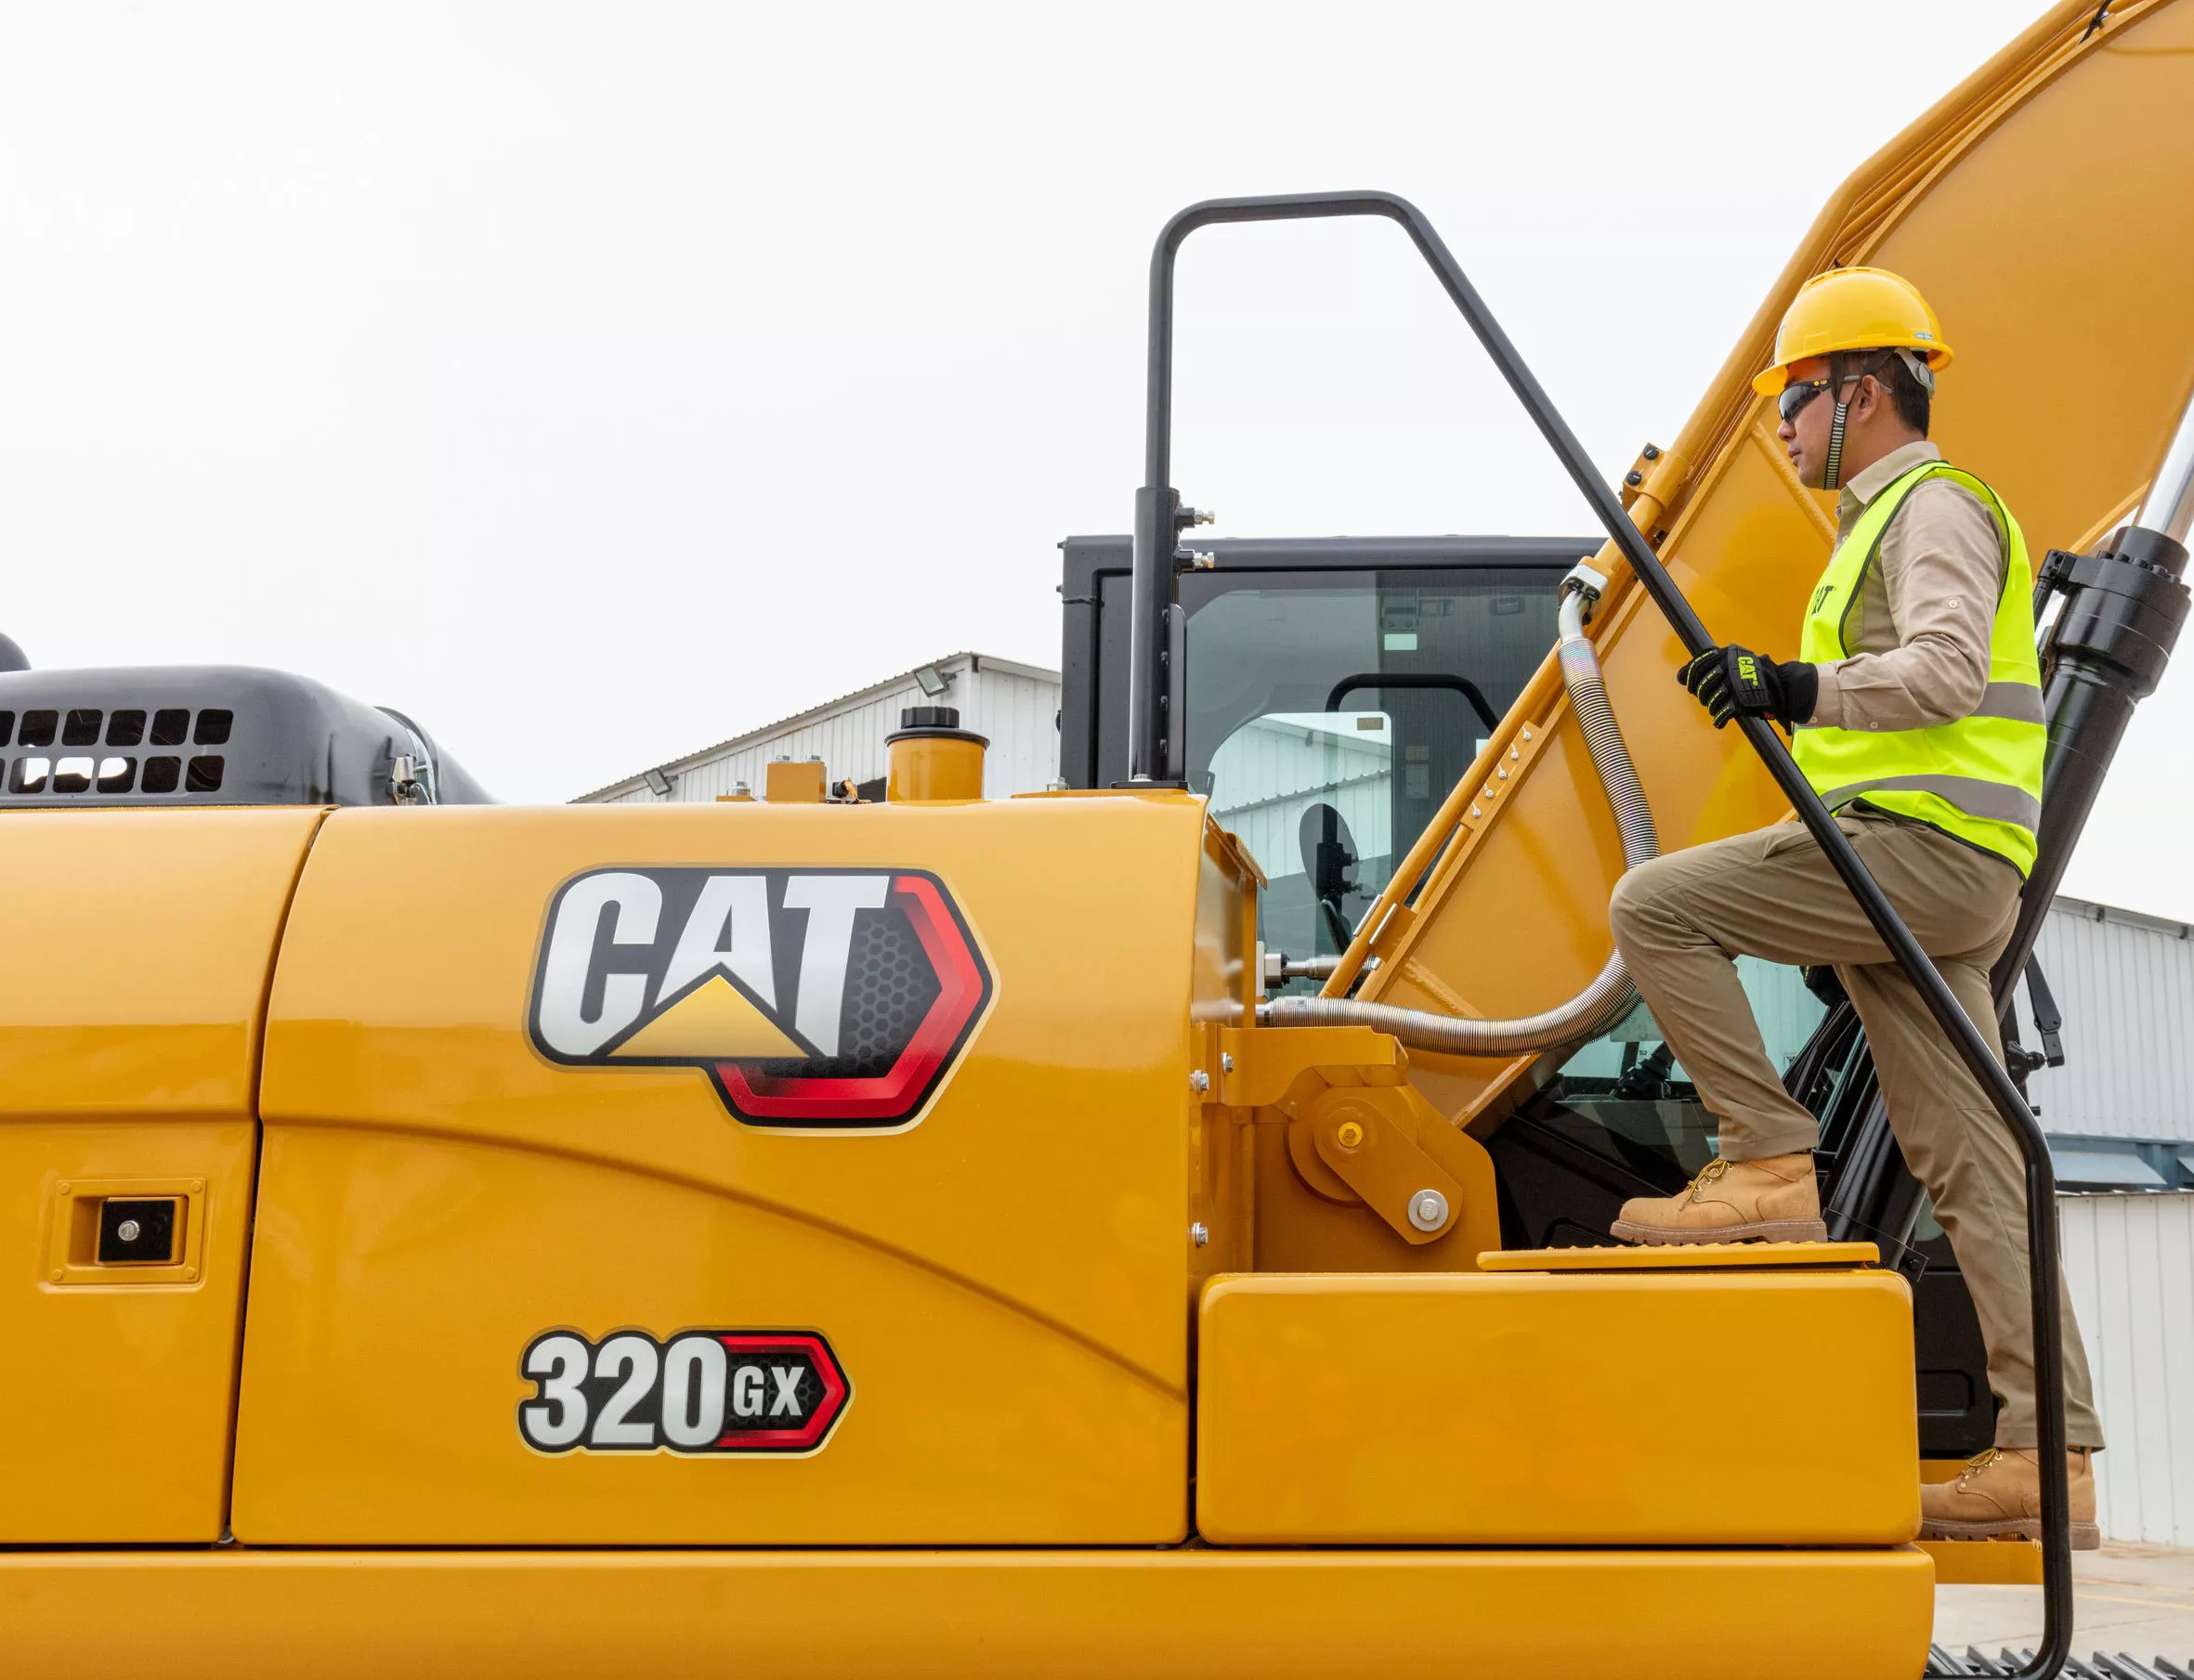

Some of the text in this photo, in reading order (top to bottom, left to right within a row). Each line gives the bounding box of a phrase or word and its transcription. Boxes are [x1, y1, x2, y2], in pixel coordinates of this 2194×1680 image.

[1738, 656, 1757, 680] CAT
[539, 872, 890, 1057] CAT
[525, 1336, 805, 1447] 320 GX
